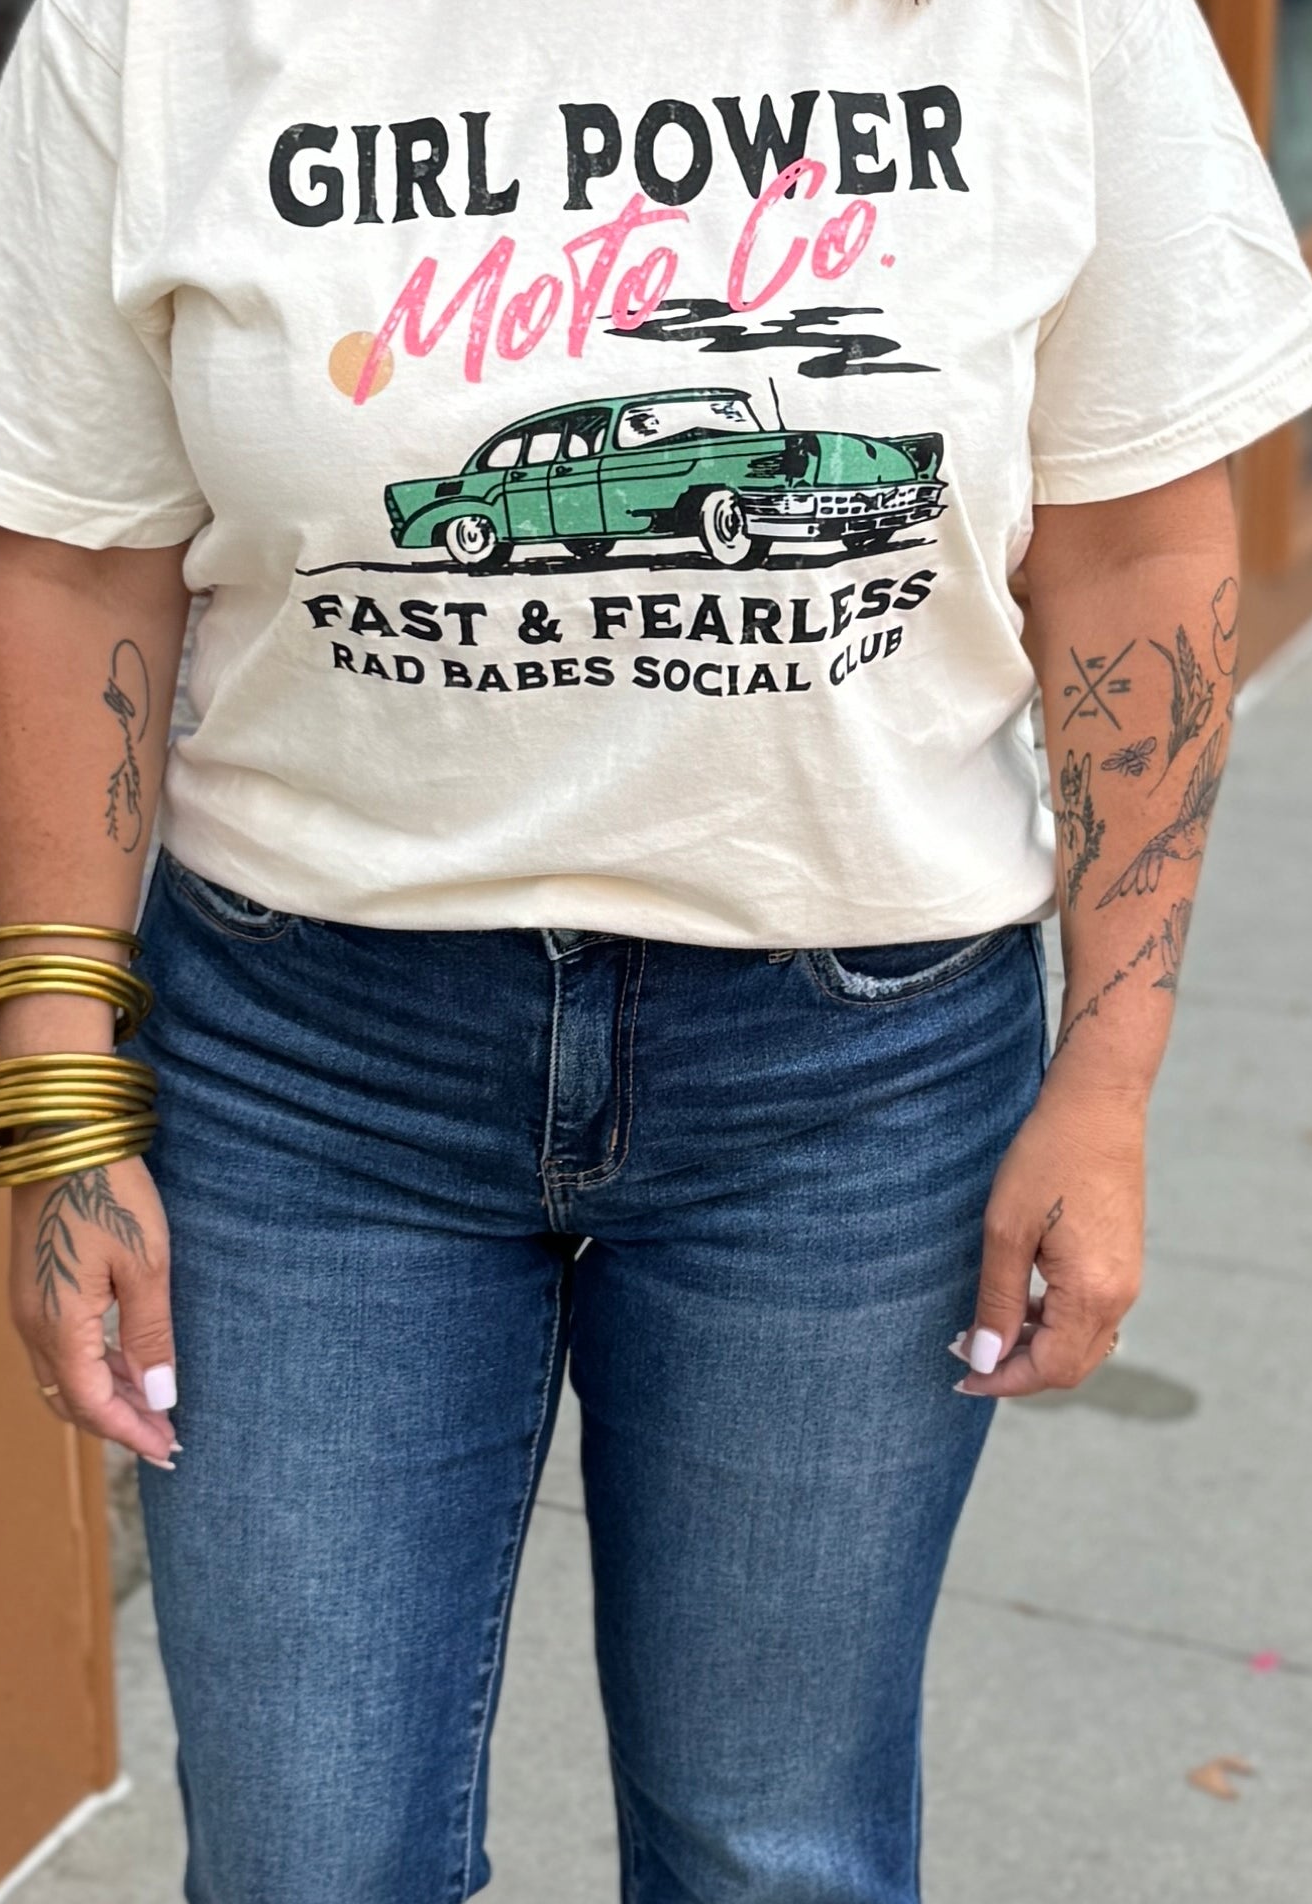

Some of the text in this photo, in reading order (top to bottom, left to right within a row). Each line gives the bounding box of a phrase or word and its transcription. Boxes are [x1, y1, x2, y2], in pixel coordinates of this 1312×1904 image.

[269, 85, 970, 228] GIRL POWER
[352, 157, 896, 406] Moto Co.
[302, 569, 938, 646] FAST & FEARLESS
[332, 625, 904, 697] RAD BABES SOCIAL CLUB
